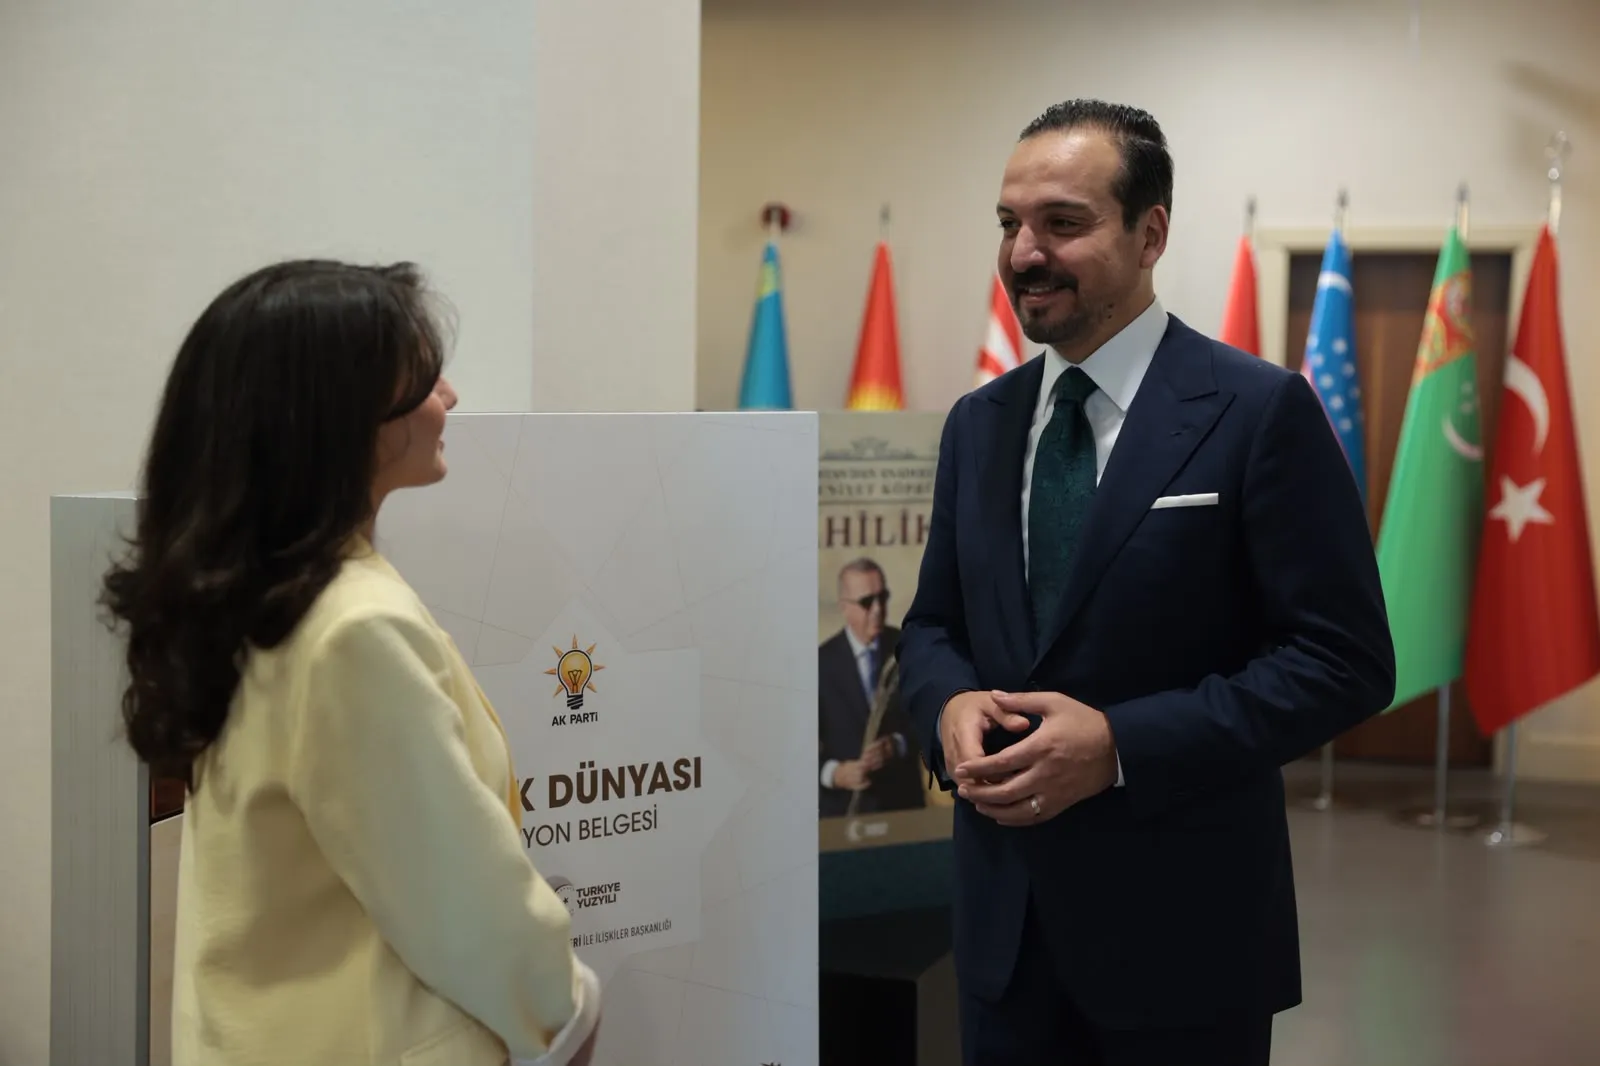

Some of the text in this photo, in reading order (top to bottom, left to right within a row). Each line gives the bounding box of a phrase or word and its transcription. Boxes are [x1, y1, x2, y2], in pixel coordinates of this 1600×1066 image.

[551, 715, 567, 727] AK
[549, 756, 702, 809] DÜNYASI
[520, 804, 657, 849] YON BELGESİ
[570, 918, 672, 949] Rİ İLE İLİŞKİLER BAŞKANLIĞI
